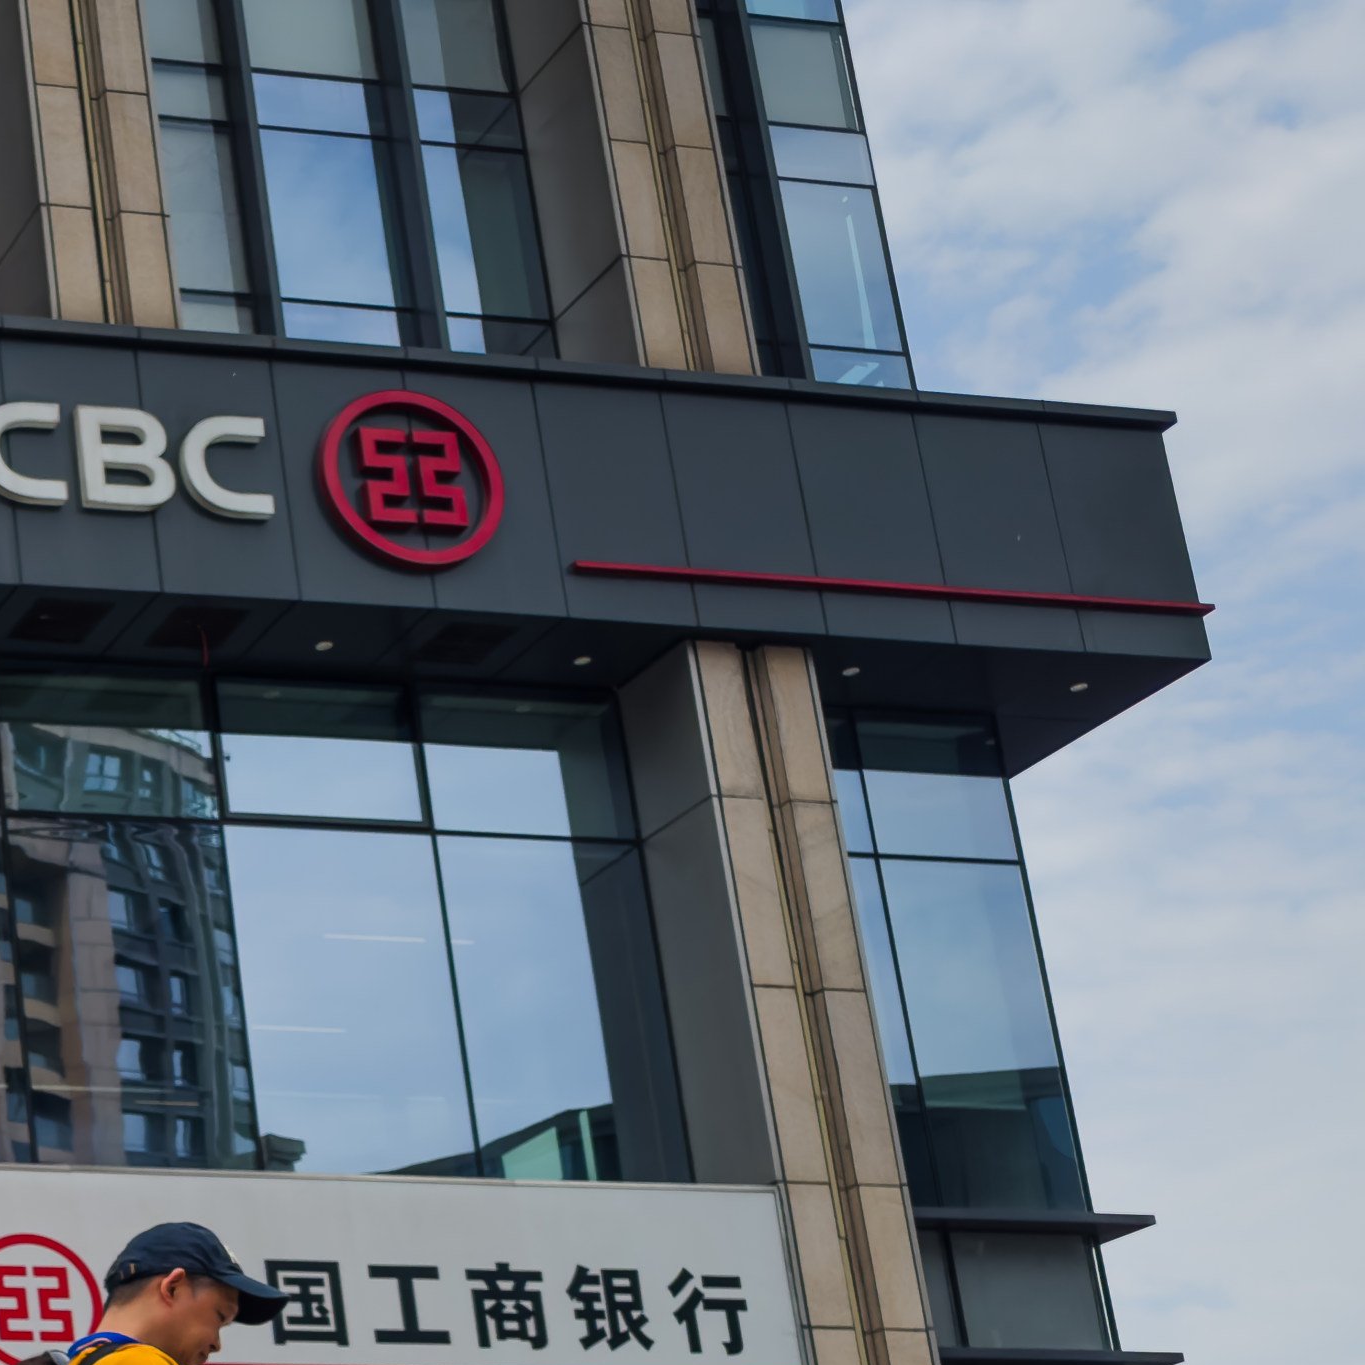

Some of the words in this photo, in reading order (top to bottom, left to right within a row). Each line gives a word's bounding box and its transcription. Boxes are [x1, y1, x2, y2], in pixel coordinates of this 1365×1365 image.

[268, 1257, 748, 1357] 国工商银行
